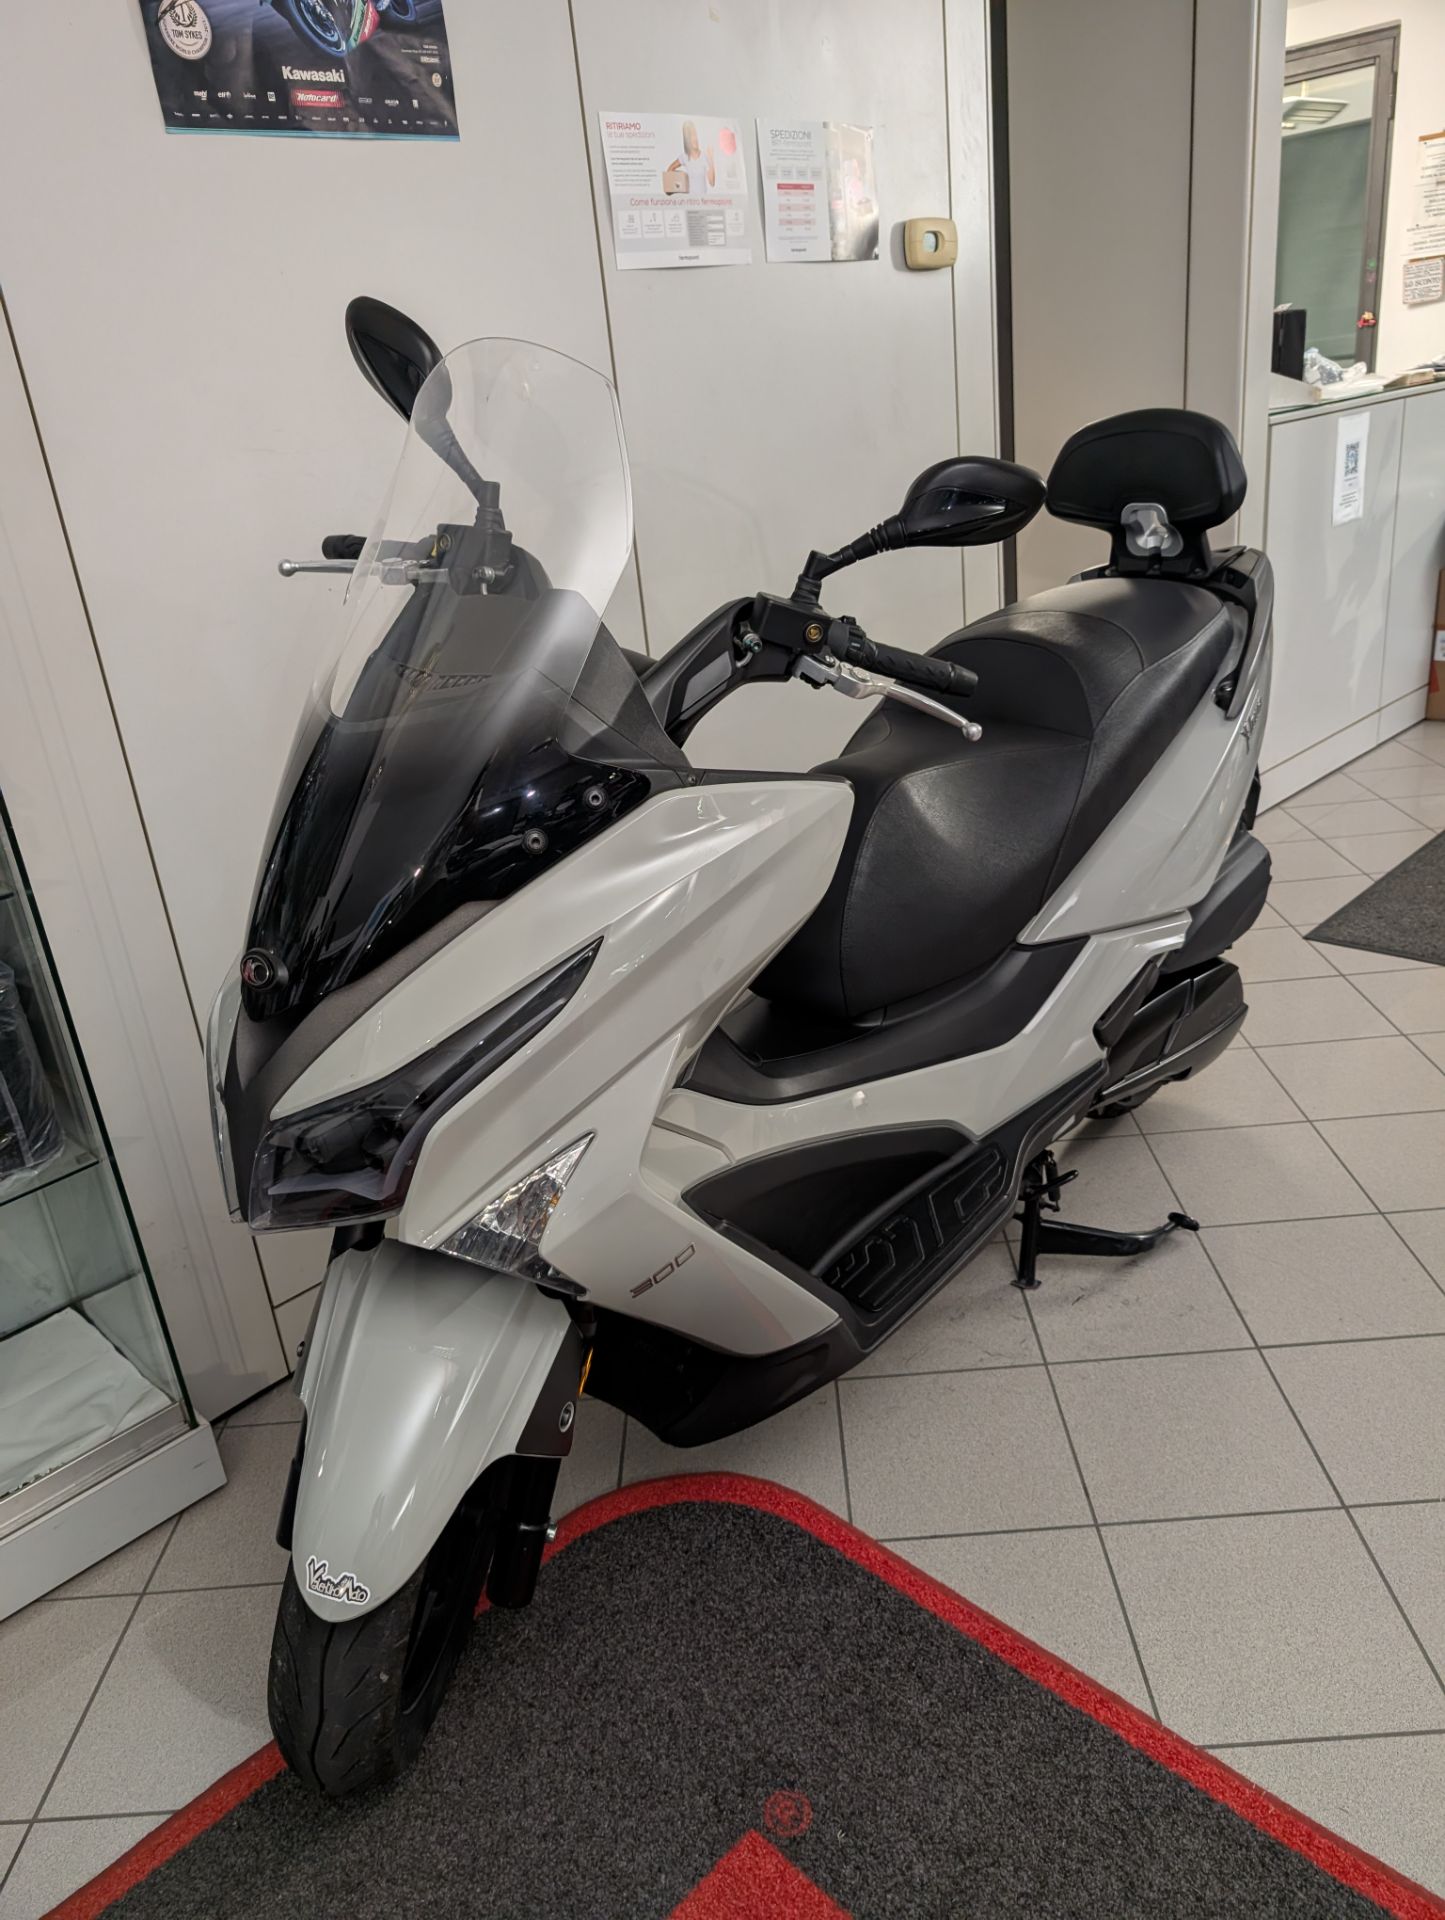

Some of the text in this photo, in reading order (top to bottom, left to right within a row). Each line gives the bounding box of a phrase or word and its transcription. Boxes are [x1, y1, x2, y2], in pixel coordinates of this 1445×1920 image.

[172, 29, 202, 40] TOM SYKES
[281, 65, 346, 83] Kawasaki
[296, 92, 337, 103] Motocard
[605, 122, 641, 130] RITIRIAMO
[770, 129, 812, 141] SPEDIZIONI
[630, 198, 649, 207] Come
[629, 1244, 696, 1299] 300
